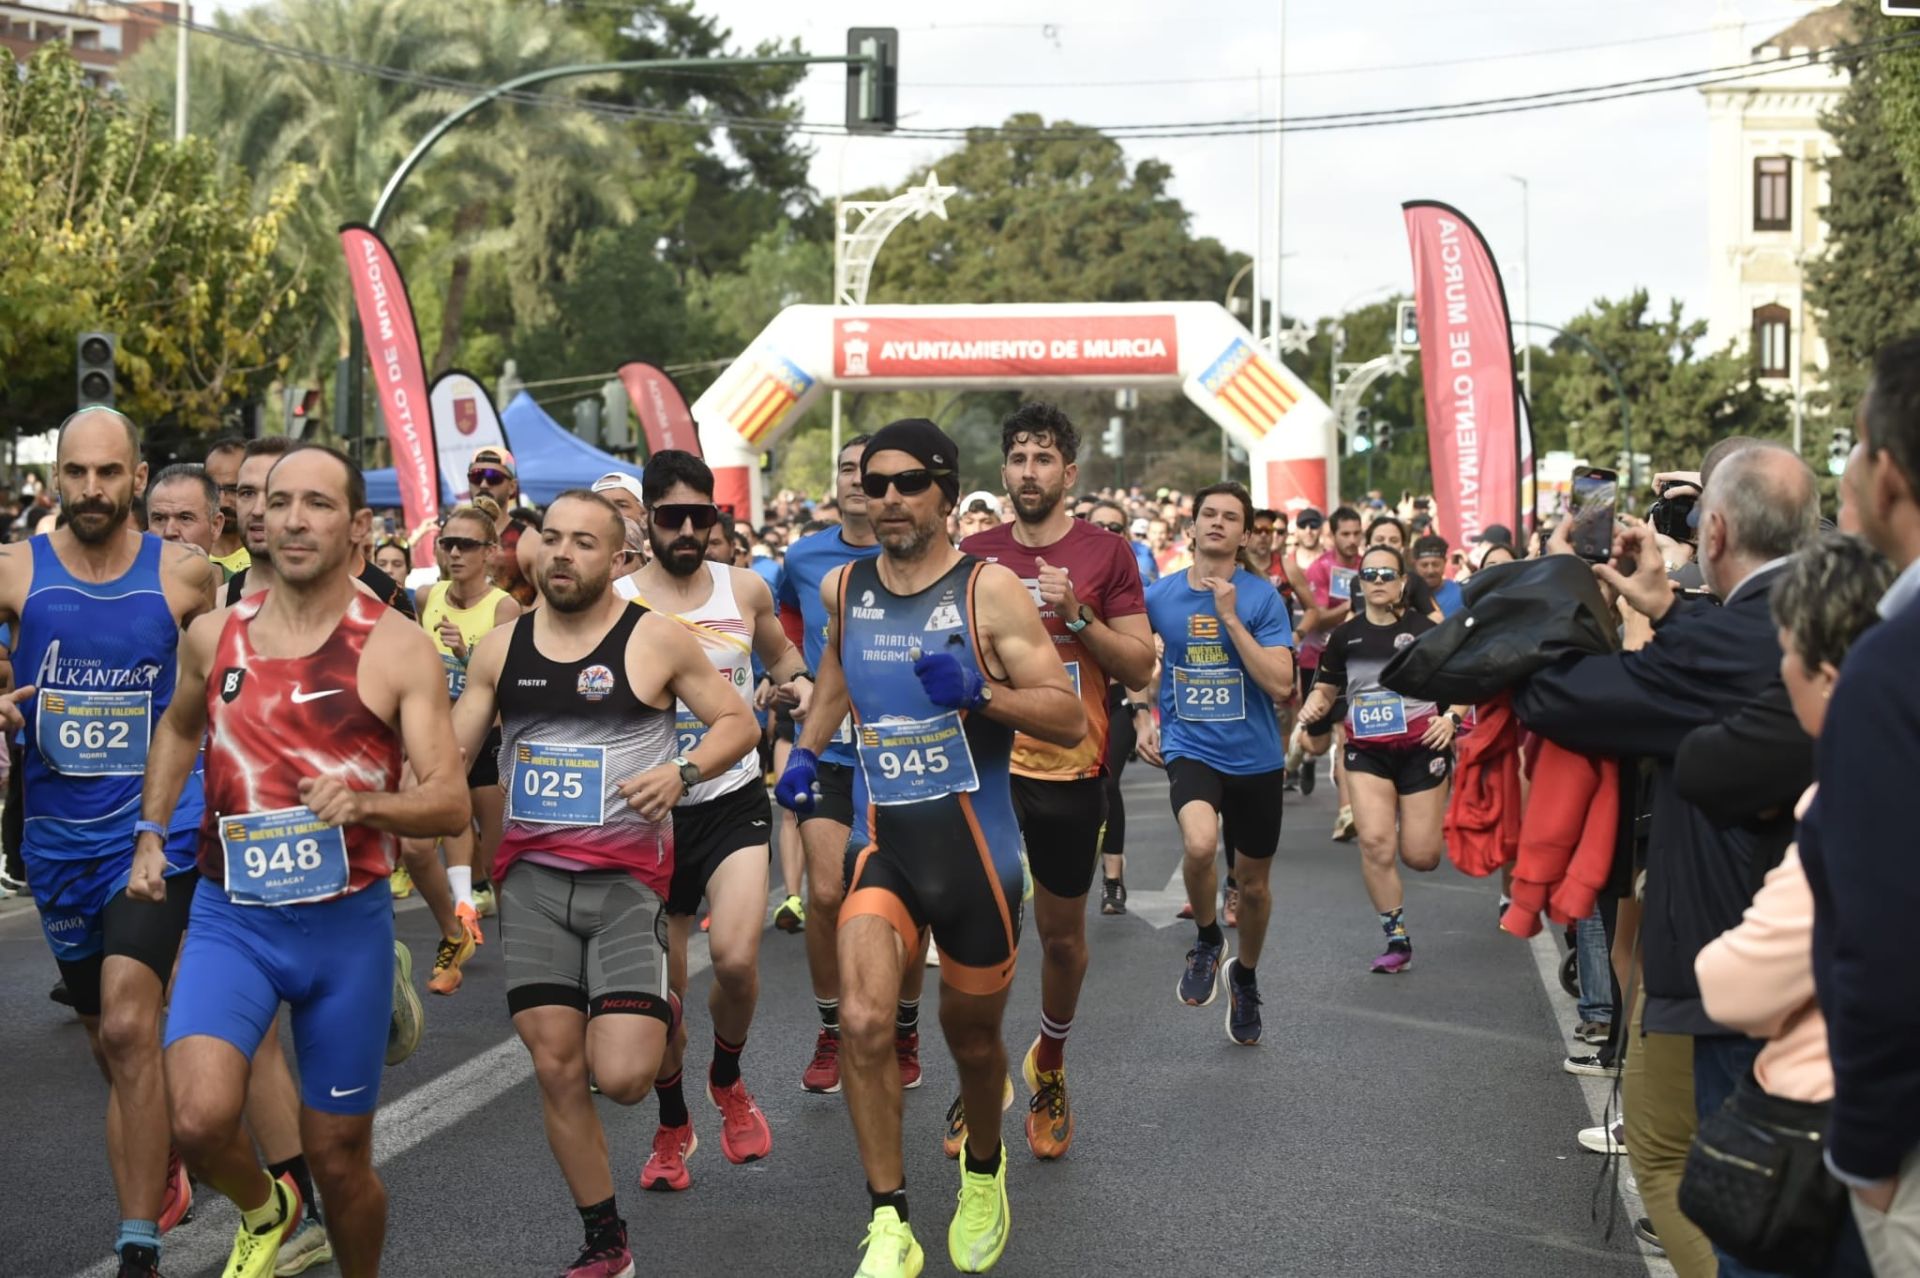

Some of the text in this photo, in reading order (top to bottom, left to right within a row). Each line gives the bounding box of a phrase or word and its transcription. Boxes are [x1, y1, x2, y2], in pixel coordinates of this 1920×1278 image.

[880, 338, 1168, 361] AYUNTAMIENTO DE MURCIA
[852, 606, 885, 620] VIATOR
[518, 679, 547, 687] FASTER
[1186, 687, 1230, 705] 228
[1360, 706, 1394, 724] 646
[59, 720, 130, 749] 662
[878, 746, 949, 779] 945
[524, 769, 583, 799] 025
[244, 838, 322, 878] 948
